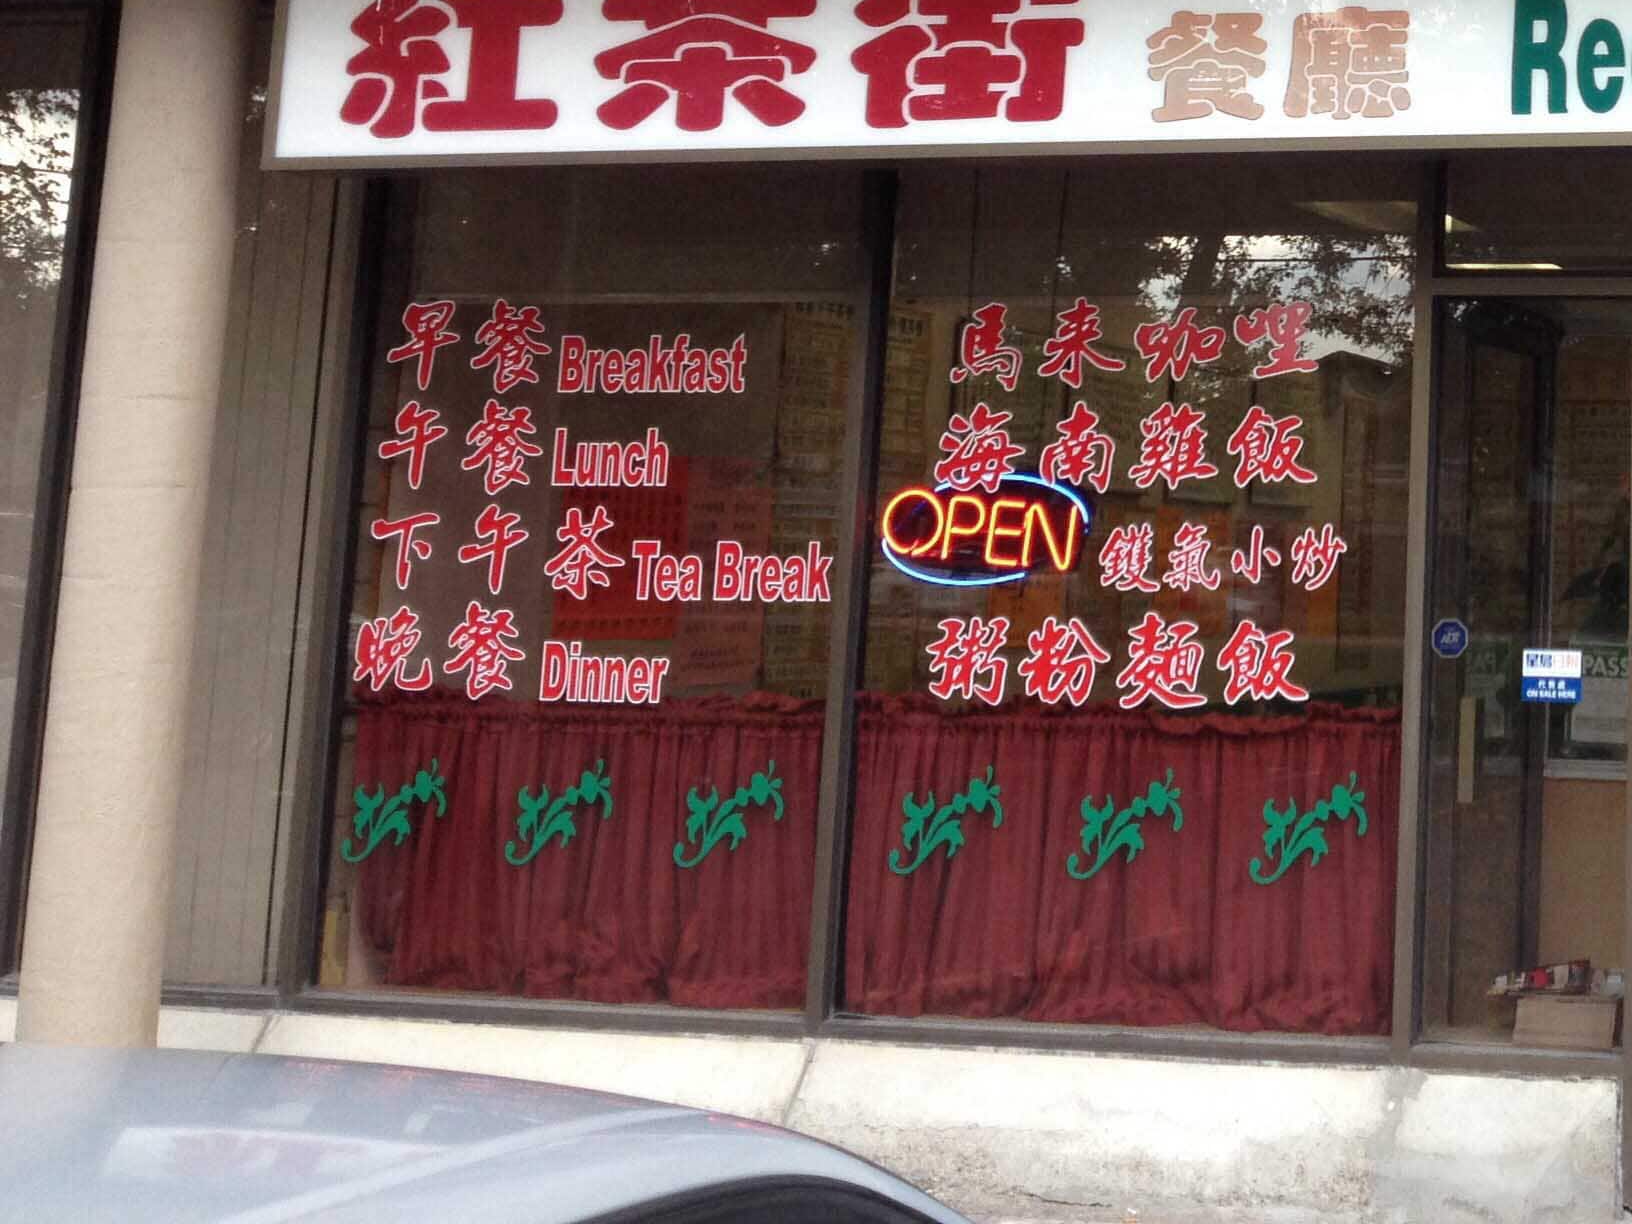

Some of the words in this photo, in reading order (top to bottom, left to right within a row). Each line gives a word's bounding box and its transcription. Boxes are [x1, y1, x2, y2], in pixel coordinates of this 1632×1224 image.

[1146, 6, 1411, 122] 餐廳
[387, 299, 552, 393] 早餐
[557, 332, 747, 393] Breakfast
[379, 399, 543, 495] 午餐
[552, 428, 668, 487] Lunch
[934, 401, 1318, 494] 海南雞飯
[371, 504, 625, 600] 下午茶
[631, 541, 702, 601] Tea
[713, 541, 833, 602] Break
[882, 488, 1081, 571] OPEN
[353, 601, 526, 700] 晚餐
[540, 641, 670, 704] Dinner
[926, 613, 1309, 709] 粥粉麵飯
